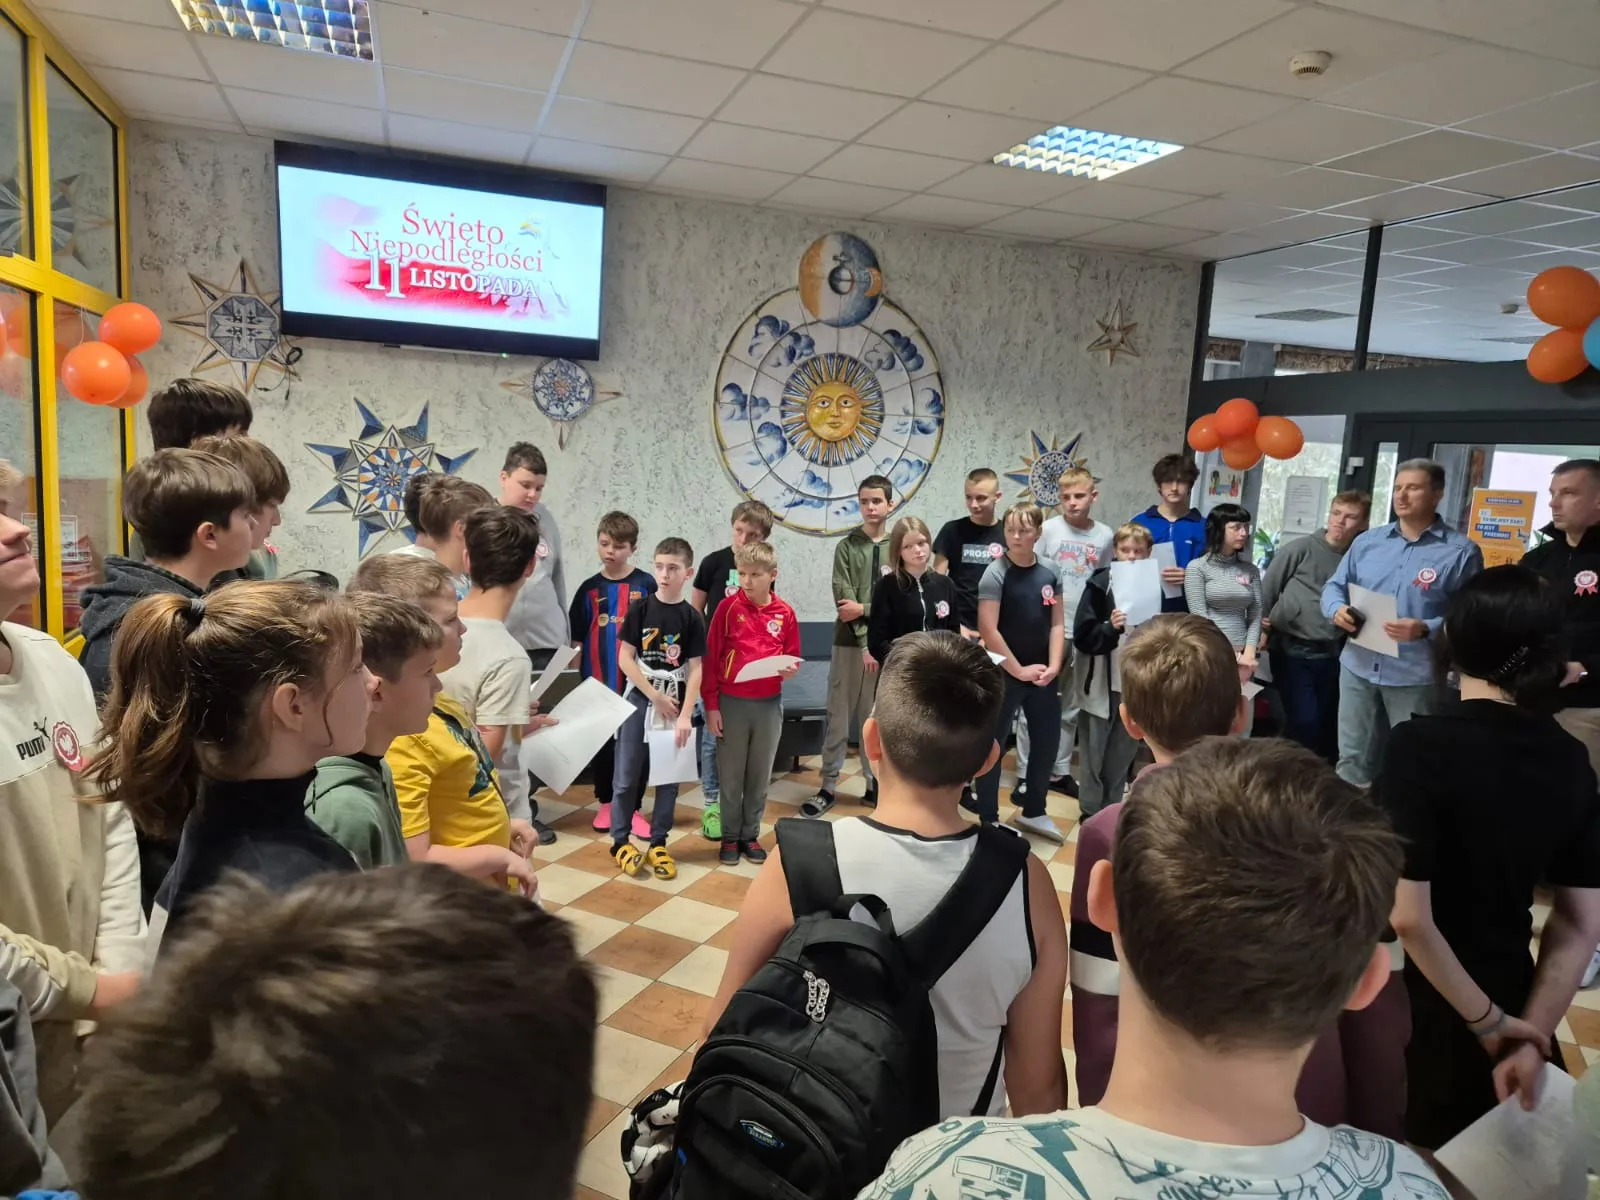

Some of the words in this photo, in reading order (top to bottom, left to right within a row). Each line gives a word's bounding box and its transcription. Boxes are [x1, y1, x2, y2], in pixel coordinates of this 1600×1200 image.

[402, 202, 504, 248] Święto
[350, 229, 543, 272] Niepodległości
[363, 248, 406, 299] 11
[409, 267, 539, 298] LISTOPADA
